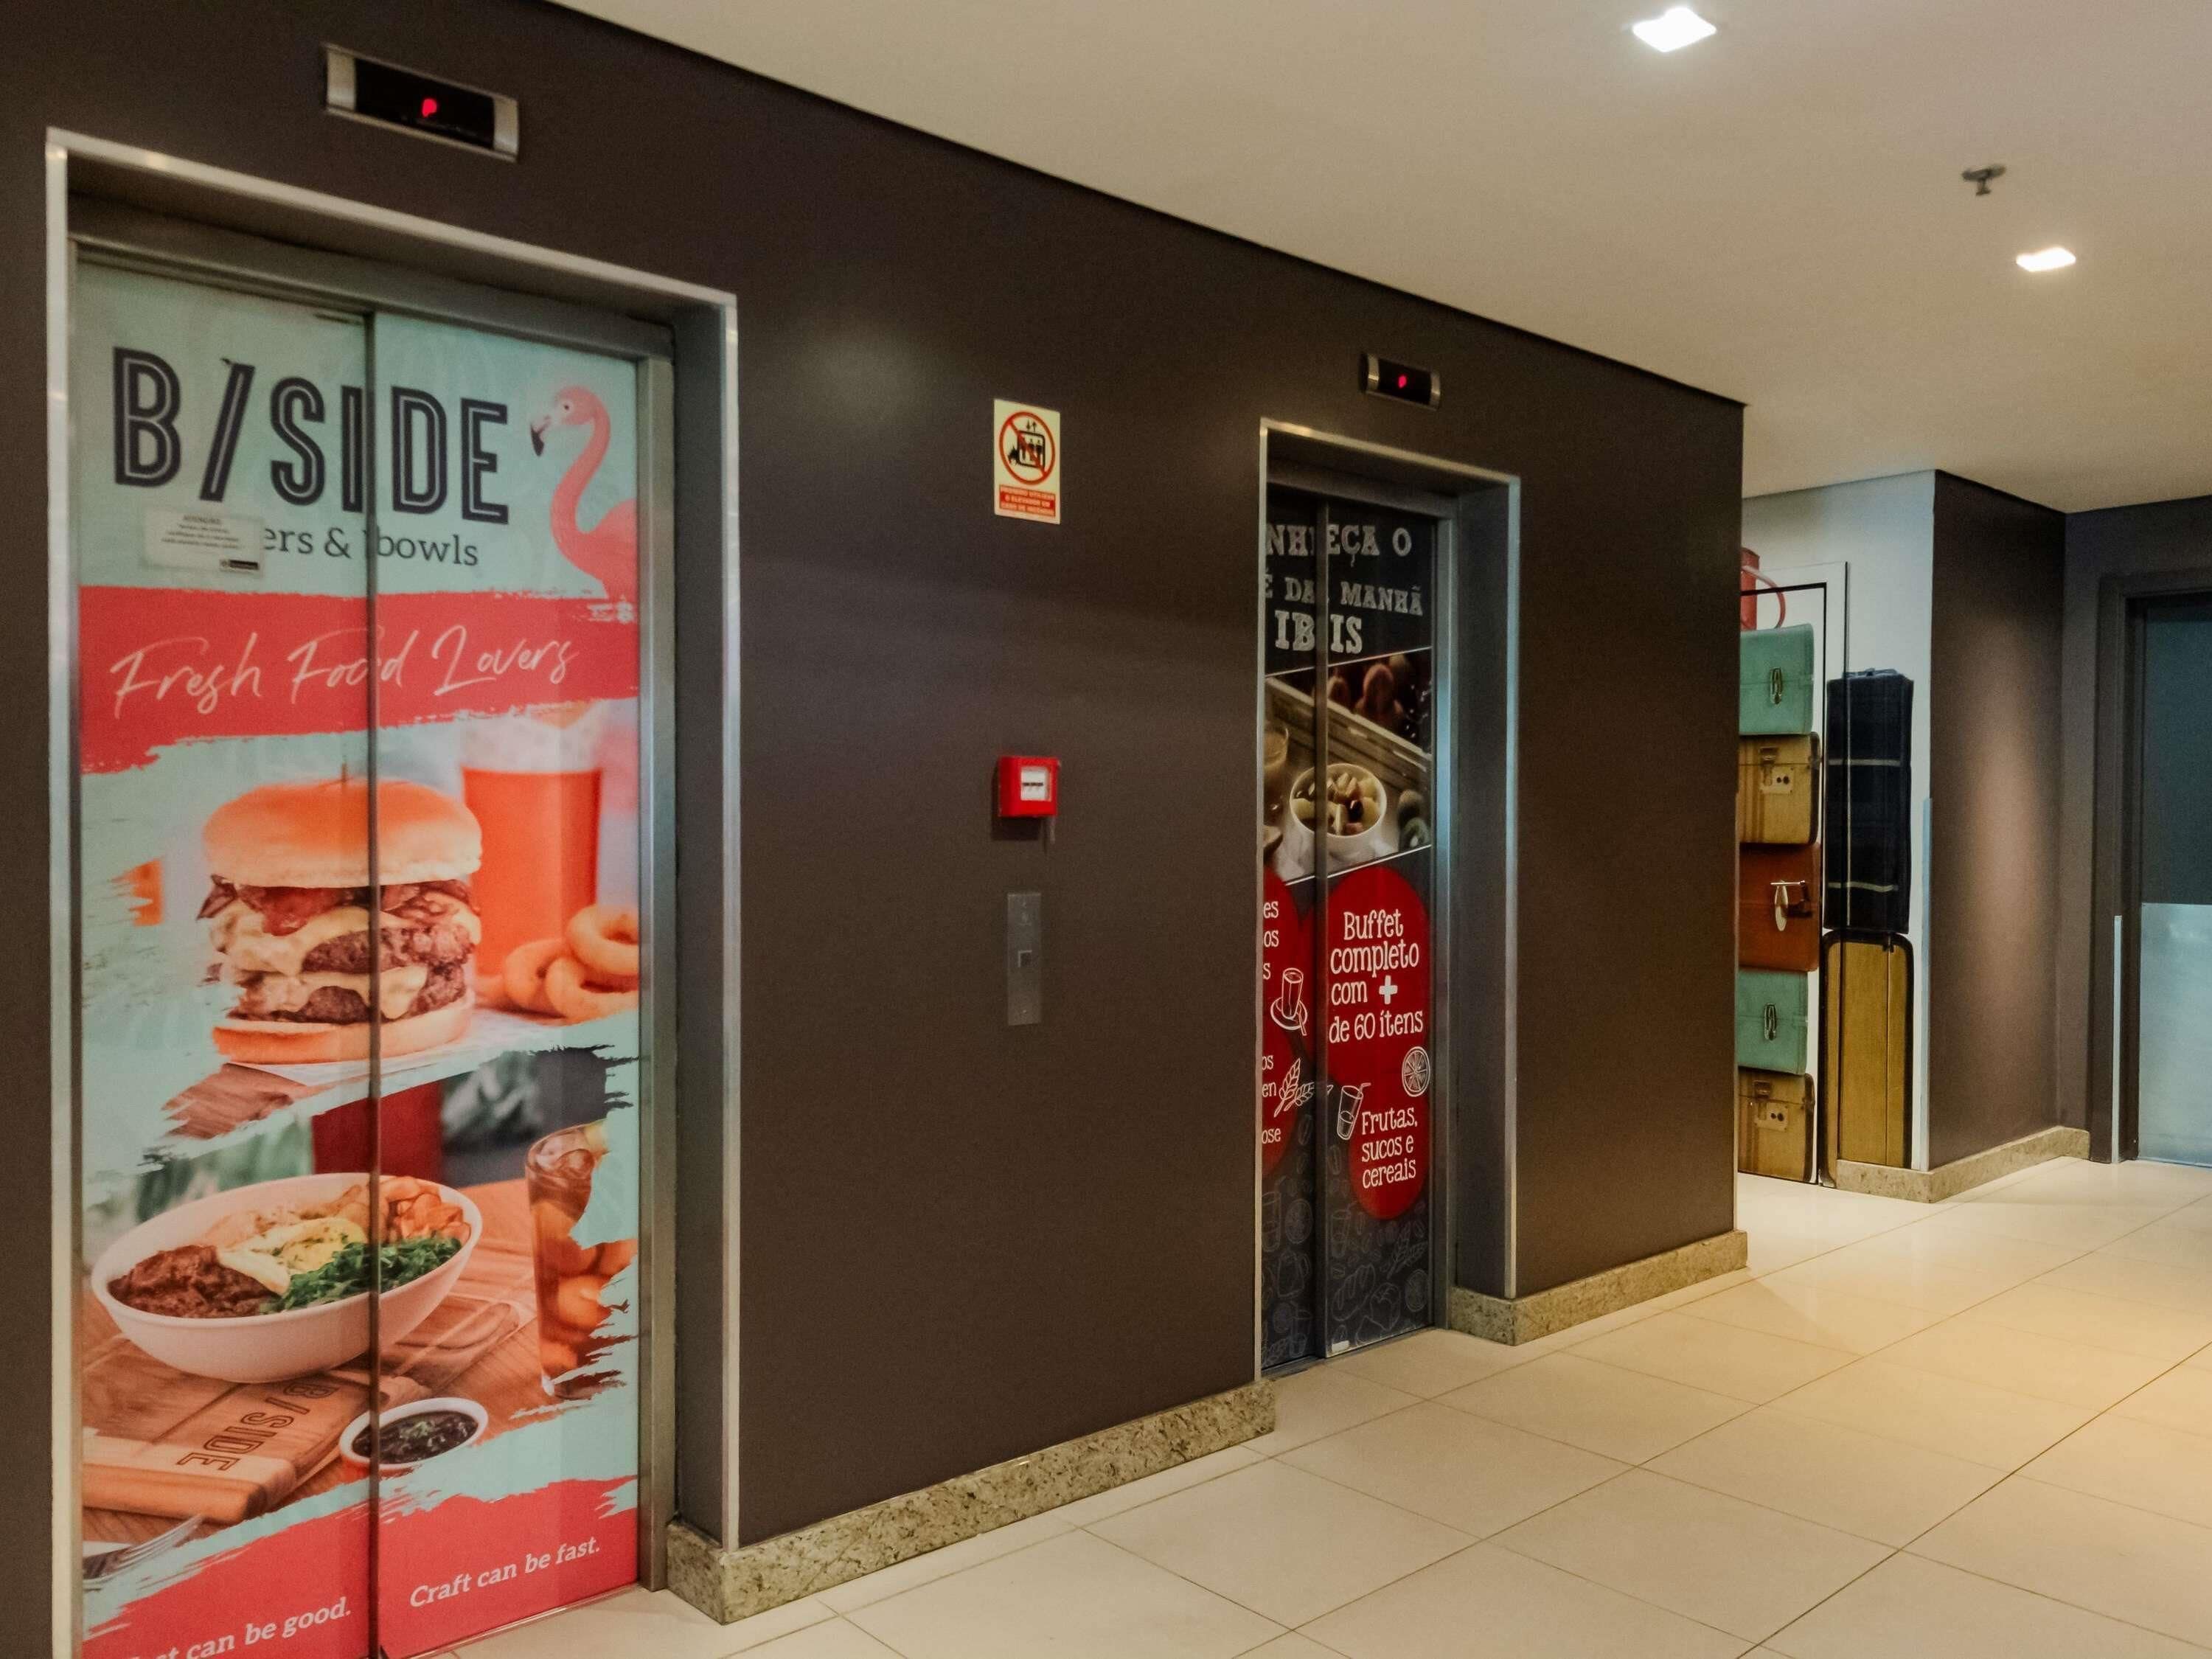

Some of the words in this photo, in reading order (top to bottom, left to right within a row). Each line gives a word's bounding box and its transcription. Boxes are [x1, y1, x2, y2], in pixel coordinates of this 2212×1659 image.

[113, 346, 509, 525] B/SIDE
[324, 526, 352, 559] &
[364, 524, 478, 566] bowls
[1392, 527, 1413, 557] O
[1340, 581, 1423, 616] MANHÃ
[1275, 610, 1363, 654] IBIS
[111, 632, 261, 720] Fresh
[287, 625, 419, 705] Food
[432, 625, 580, 696] Lovers
[1343, 908, 1404, 941] Buffet
[1330, 939, 1419, 978] completo
[1331, 981, 1368, 1006] com
[1329, 1016, 1350, 1043] de
[1354, 1012, 1376, 1040] 60
[1362, 1136, 1402, 1163] sucos
[1405, 1135, 1414, 1153] e
[1362, 1158, 1416, 1189] cereais
[410, 1572, 473, 1608] Craft
[476, 1563, 517, 1587] can
[524, 1554, 551, 1574] be
[554, 1536, 600, 1565] fast.
[187, 1634, 235, 1659] can
[244, 1623, 277, 1646] be
[282, 1596, 351, 1638] good.
